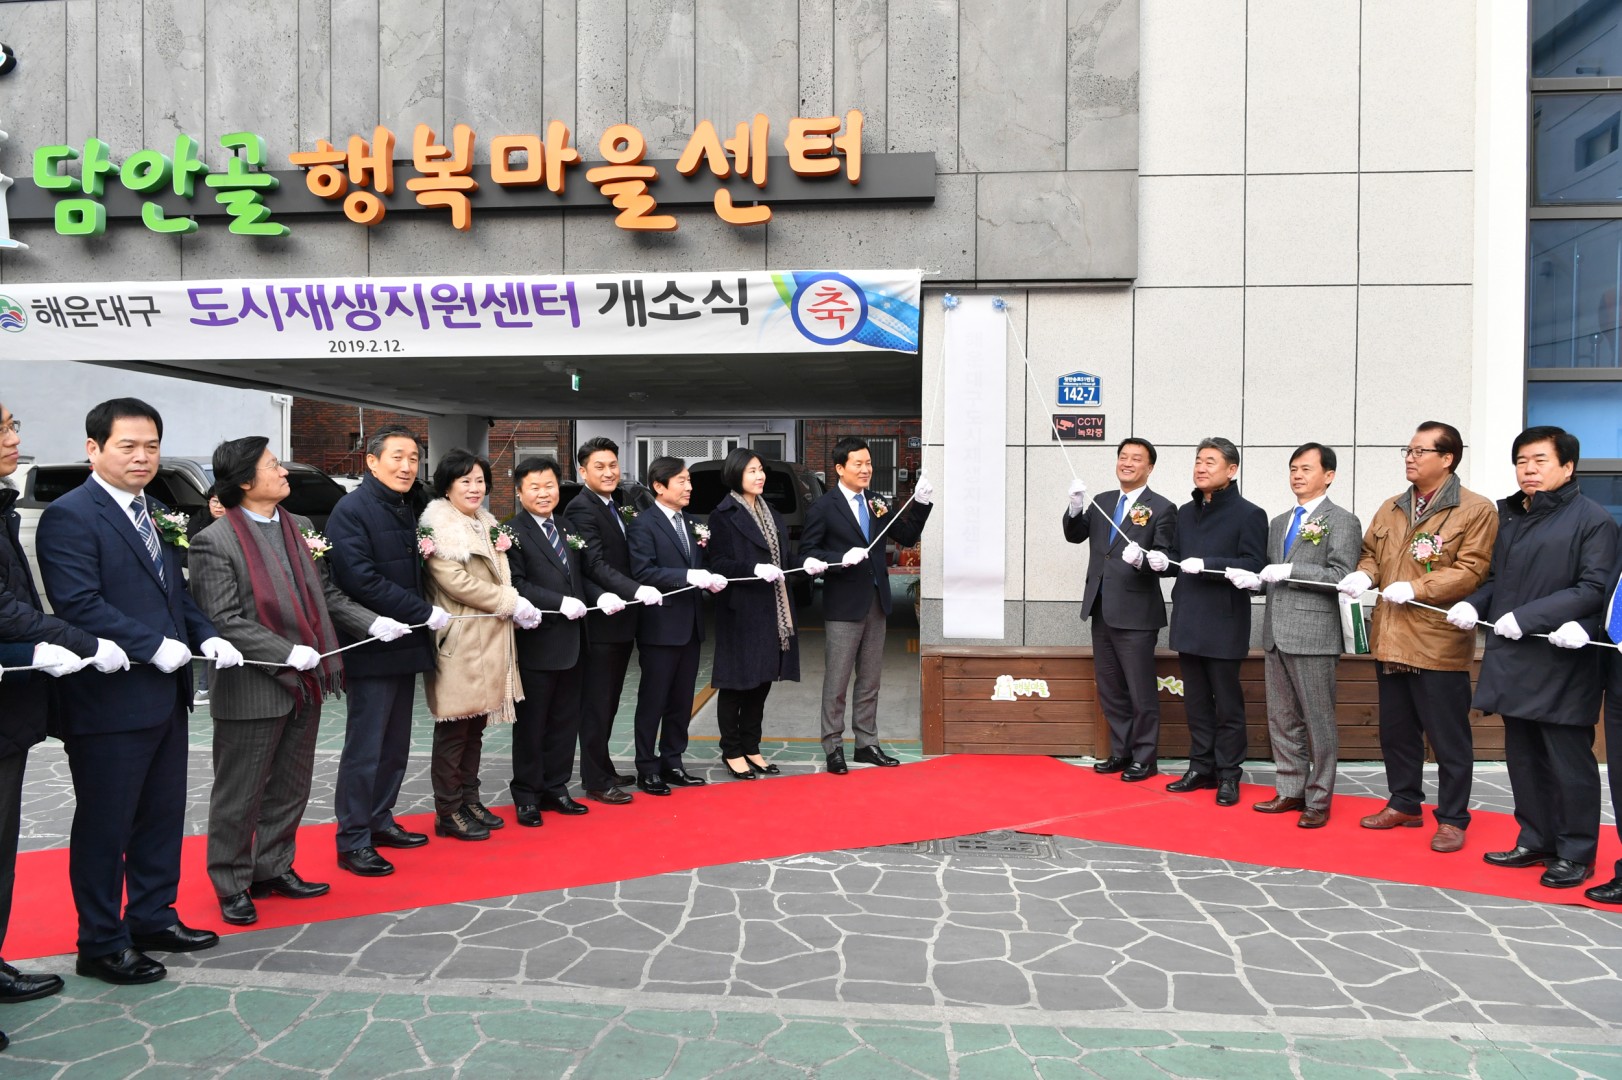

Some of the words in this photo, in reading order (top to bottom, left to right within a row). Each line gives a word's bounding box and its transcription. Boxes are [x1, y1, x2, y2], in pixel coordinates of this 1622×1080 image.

[33, 131, 291, 238] 담안골
[289, 109, 865, 233] 행복마을센터
[30, 294, 161, 329] 해운대구
[186, 281, 581, 332] 도시재생지원센터
[595, 278, 750, 328] 개소식
[806, 286, 855, 331] 축
[328, 339, 406, 354] 2019.2.12.
[1063, 387, 1095, 401] 142-7
[1077, 417, 1103, 426] CCTV
[1077, 428, 1103, 438] 녹화중
